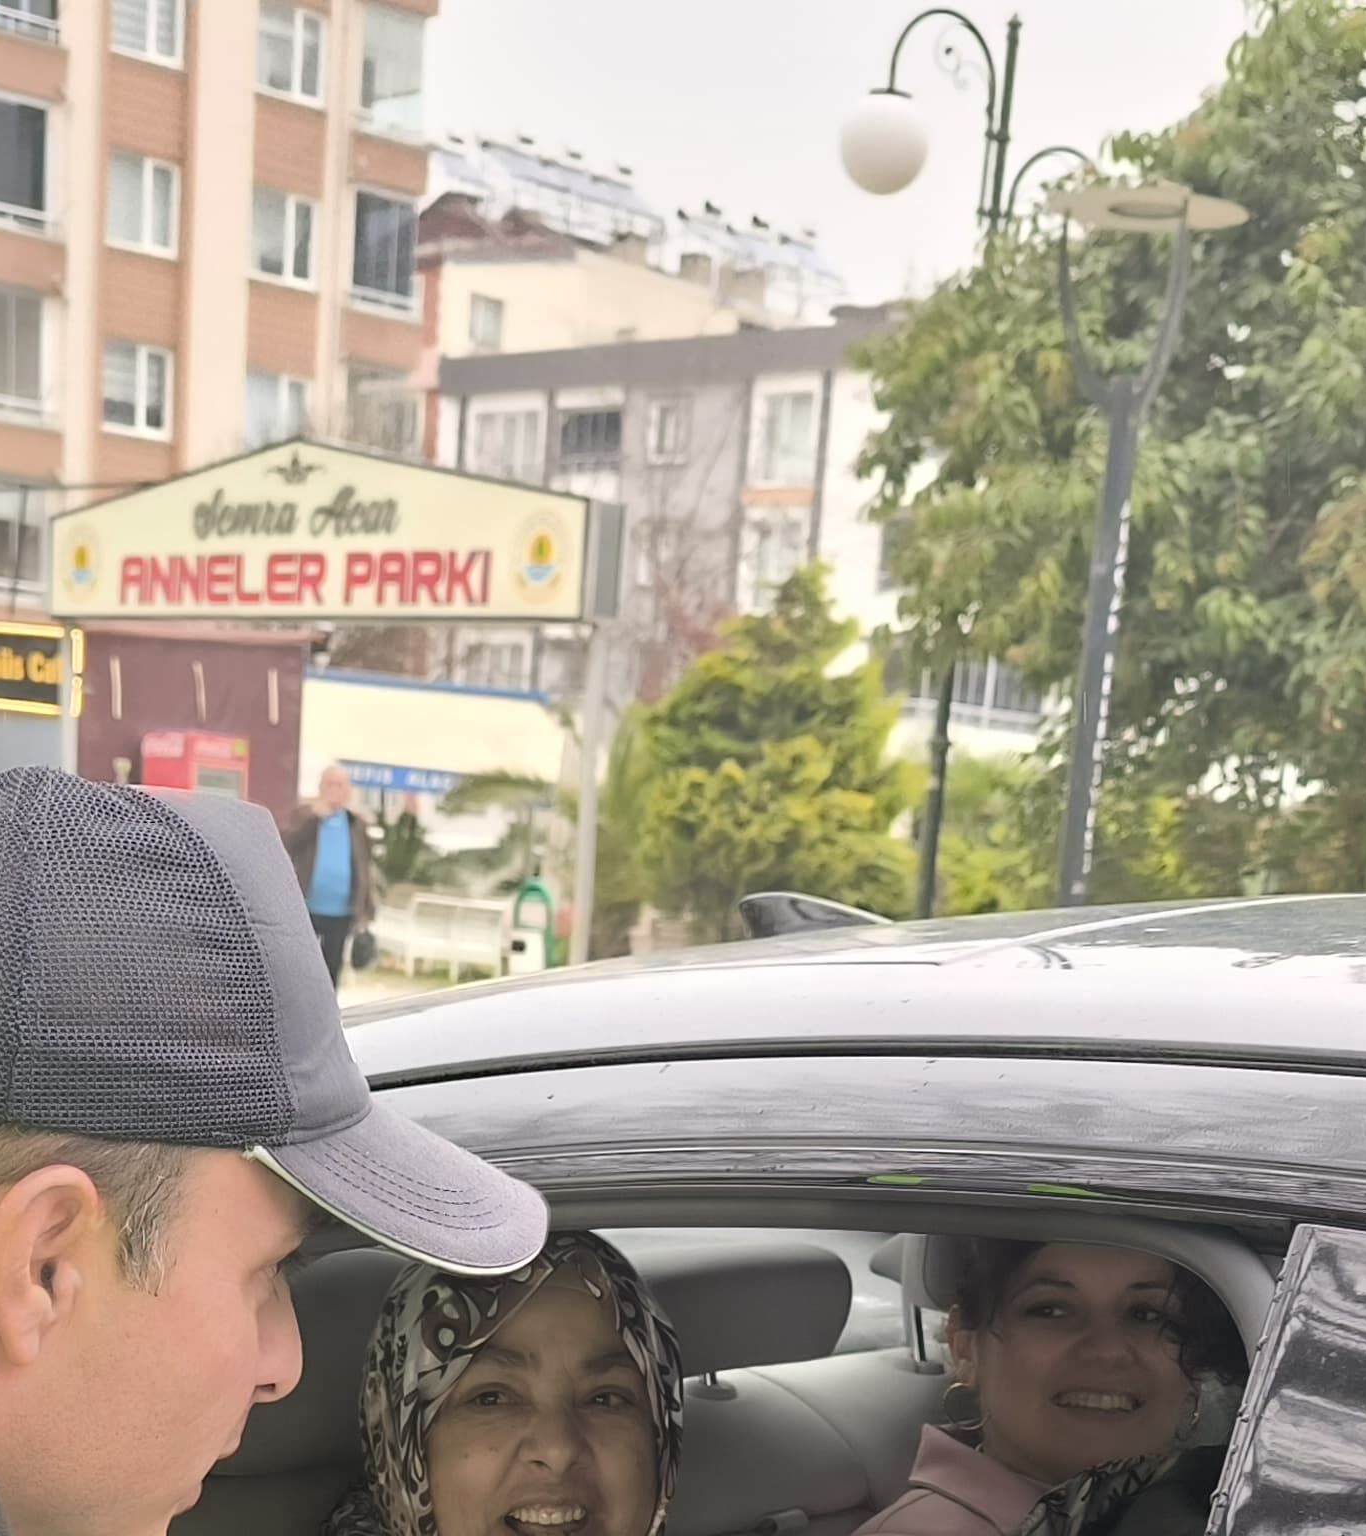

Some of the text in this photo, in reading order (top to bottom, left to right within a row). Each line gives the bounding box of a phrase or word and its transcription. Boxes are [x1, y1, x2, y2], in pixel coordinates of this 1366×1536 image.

[193, 485, 401, 540] Semra Acar
[120, 550, 493, 606] ANNELER PARKI
